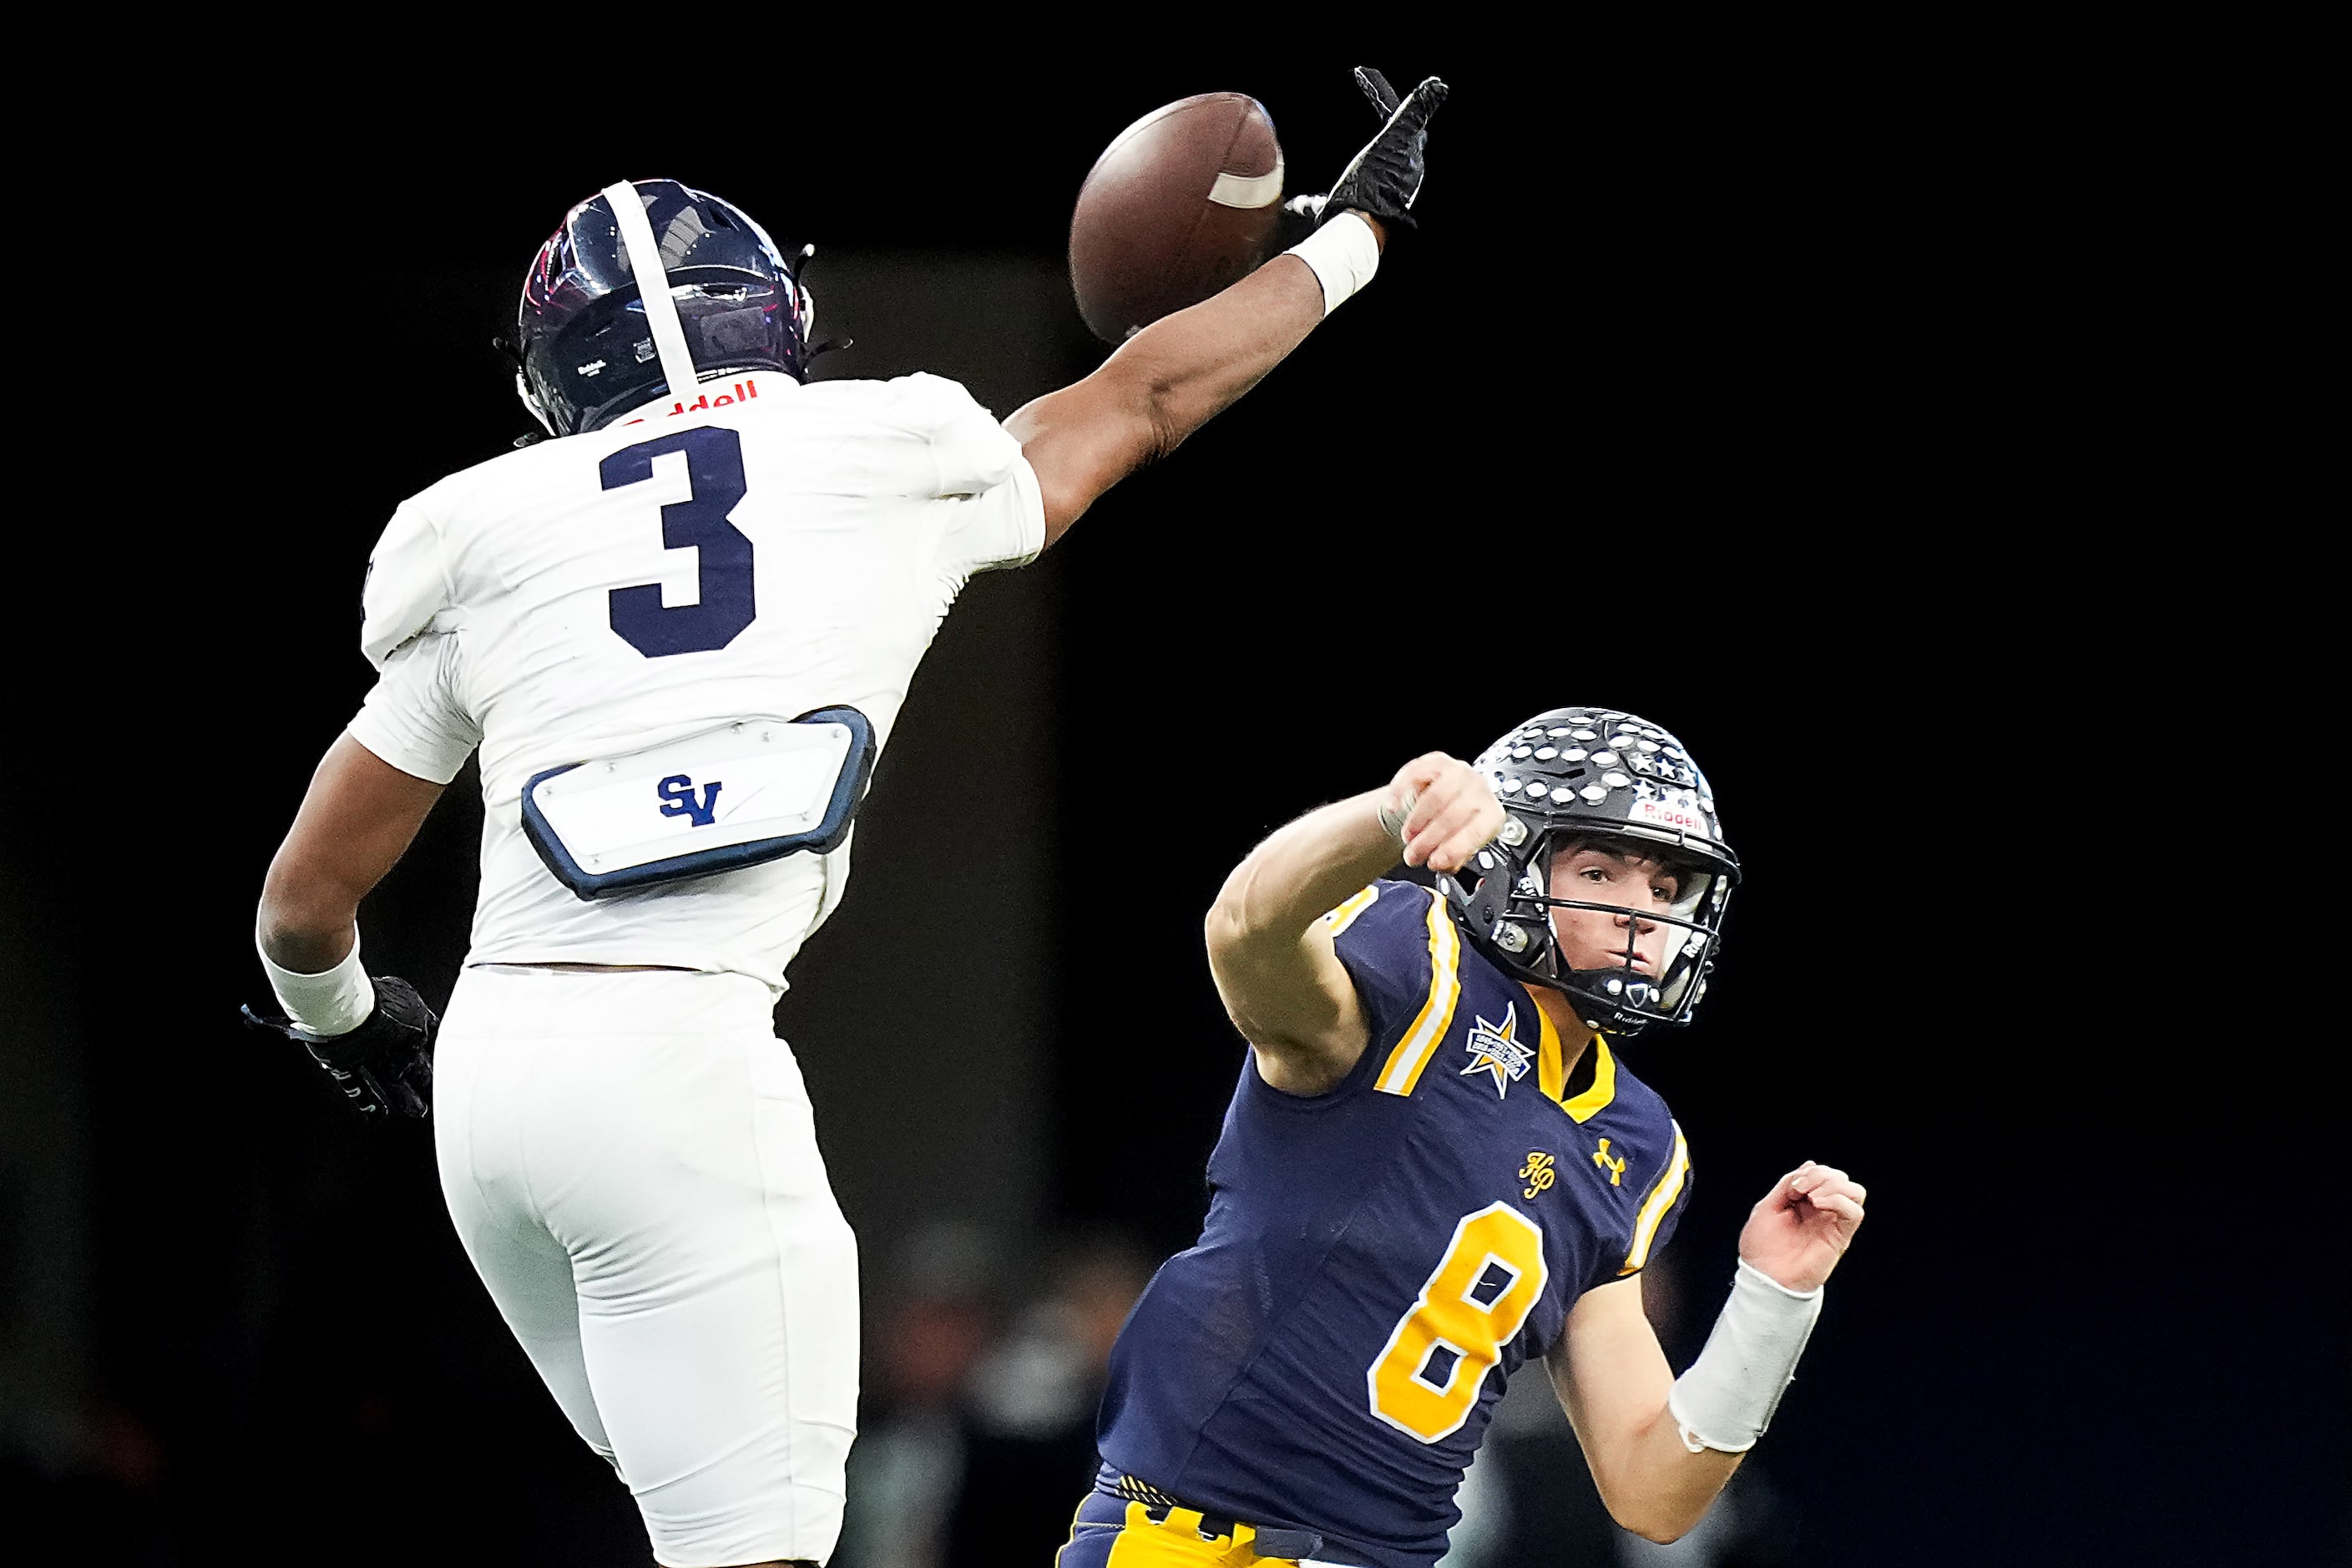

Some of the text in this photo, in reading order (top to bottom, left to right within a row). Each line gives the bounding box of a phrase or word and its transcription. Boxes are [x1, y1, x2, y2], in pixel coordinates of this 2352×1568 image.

[599, 426, 756, 659] 3
[657, 773, 722, 827] SV
[1644, 803, 1702, 831] Riddell
[1367, 1200, 1550, 1445] 8
